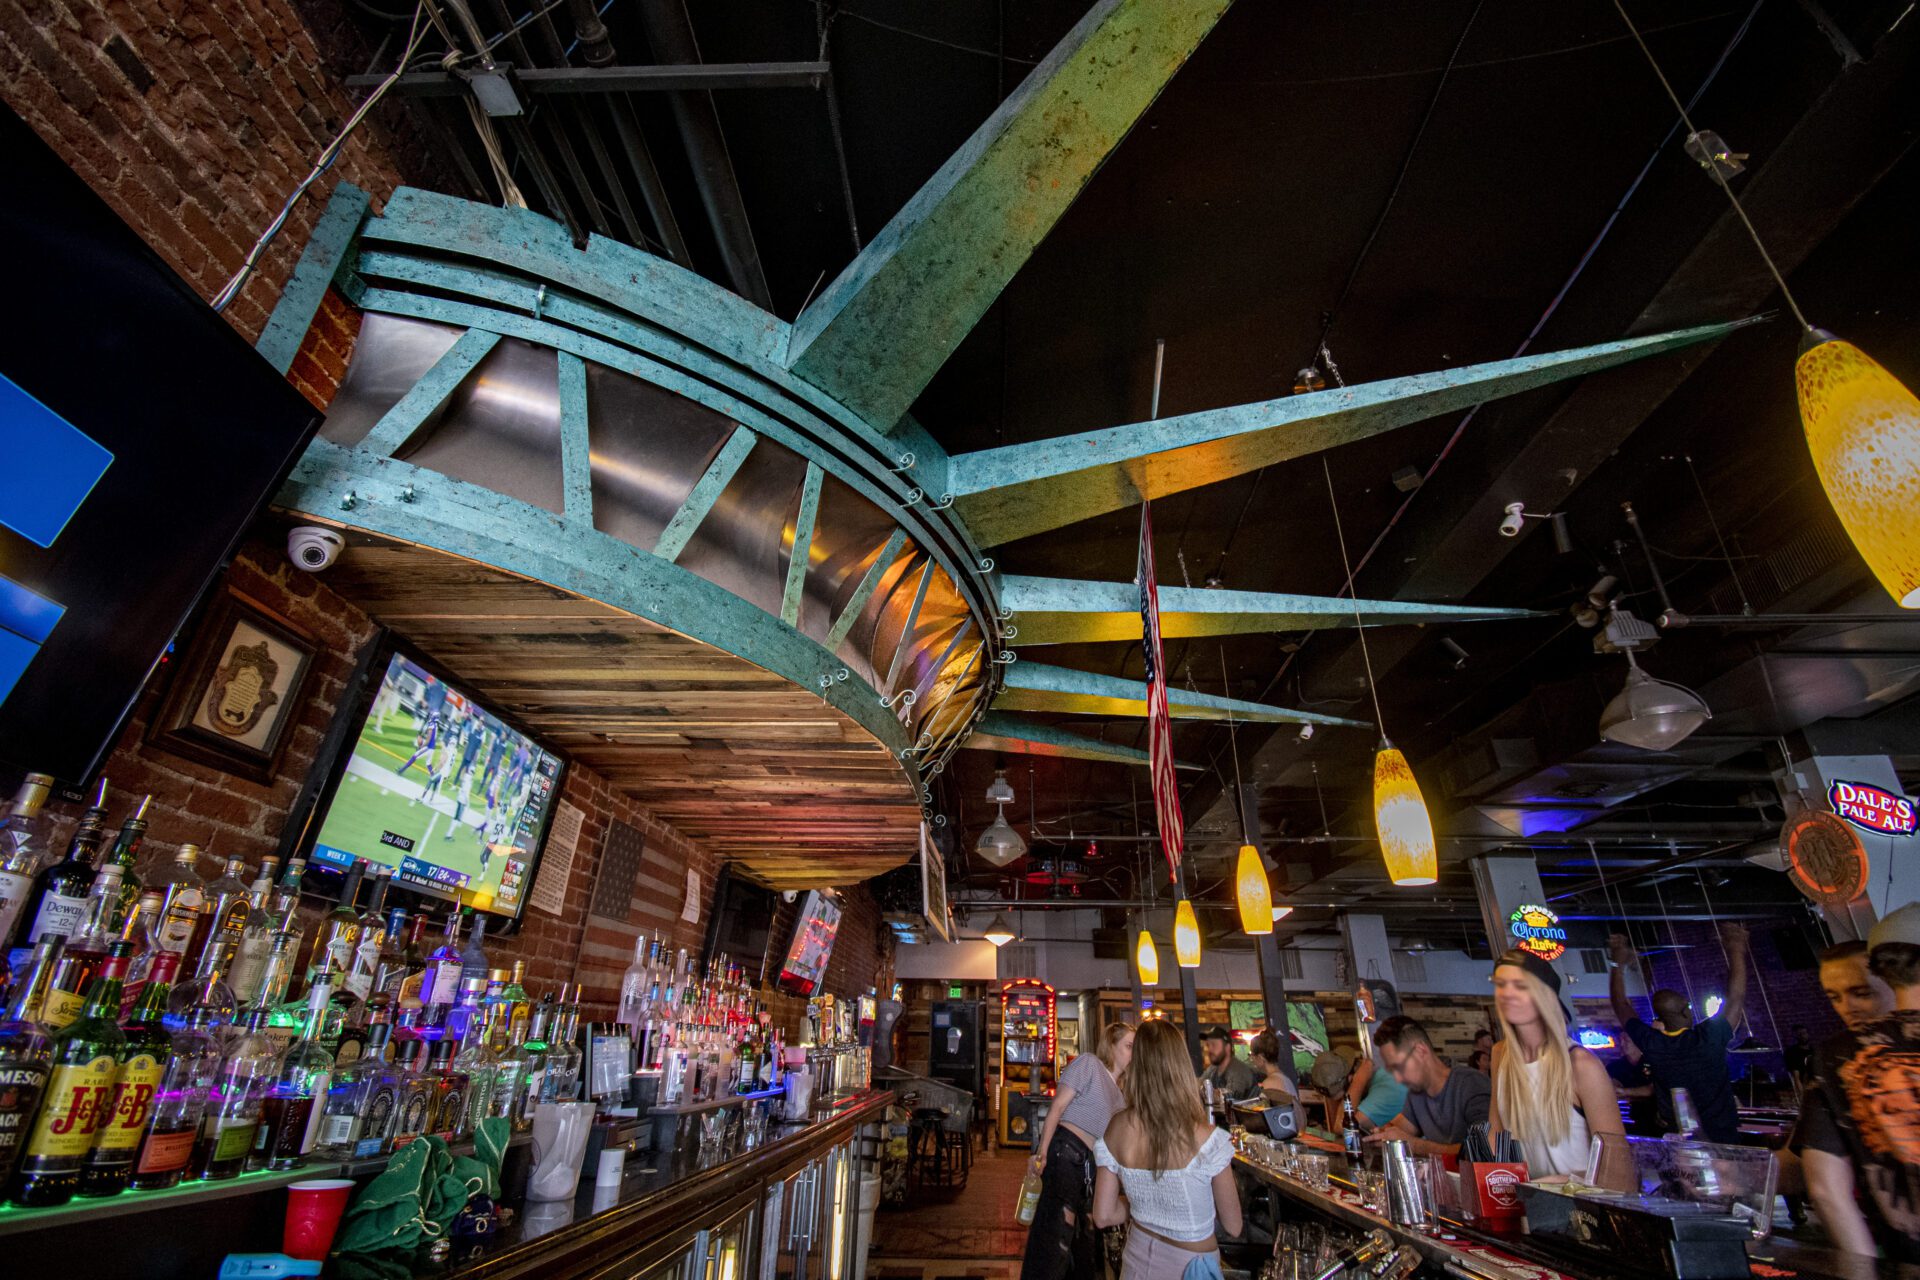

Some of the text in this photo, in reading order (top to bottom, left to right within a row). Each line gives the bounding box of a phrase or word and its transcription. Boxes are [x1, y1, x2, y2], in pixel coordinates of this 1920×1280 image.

[1837, 783, 1911, 819] DALE'S
[1839, 802, 1912, 832] PALE ALE
[382, 832, 410, 849] 3rd AND
[327, 850, 347, 861] WEEK 3
[428, 866, 438, 876] 17
[438, 870, 448, 880] 24
[59, 918, 69, 927] 12
[1512, 922, 1567, 940] Corona
[51, 1086, 109, 1135] J&B
[98, 1083, 154, 1129] J&B
[1488, 1174, 1517, 1186] SOUTHERN
[1570, 1208, 1599, 1228] MESON
